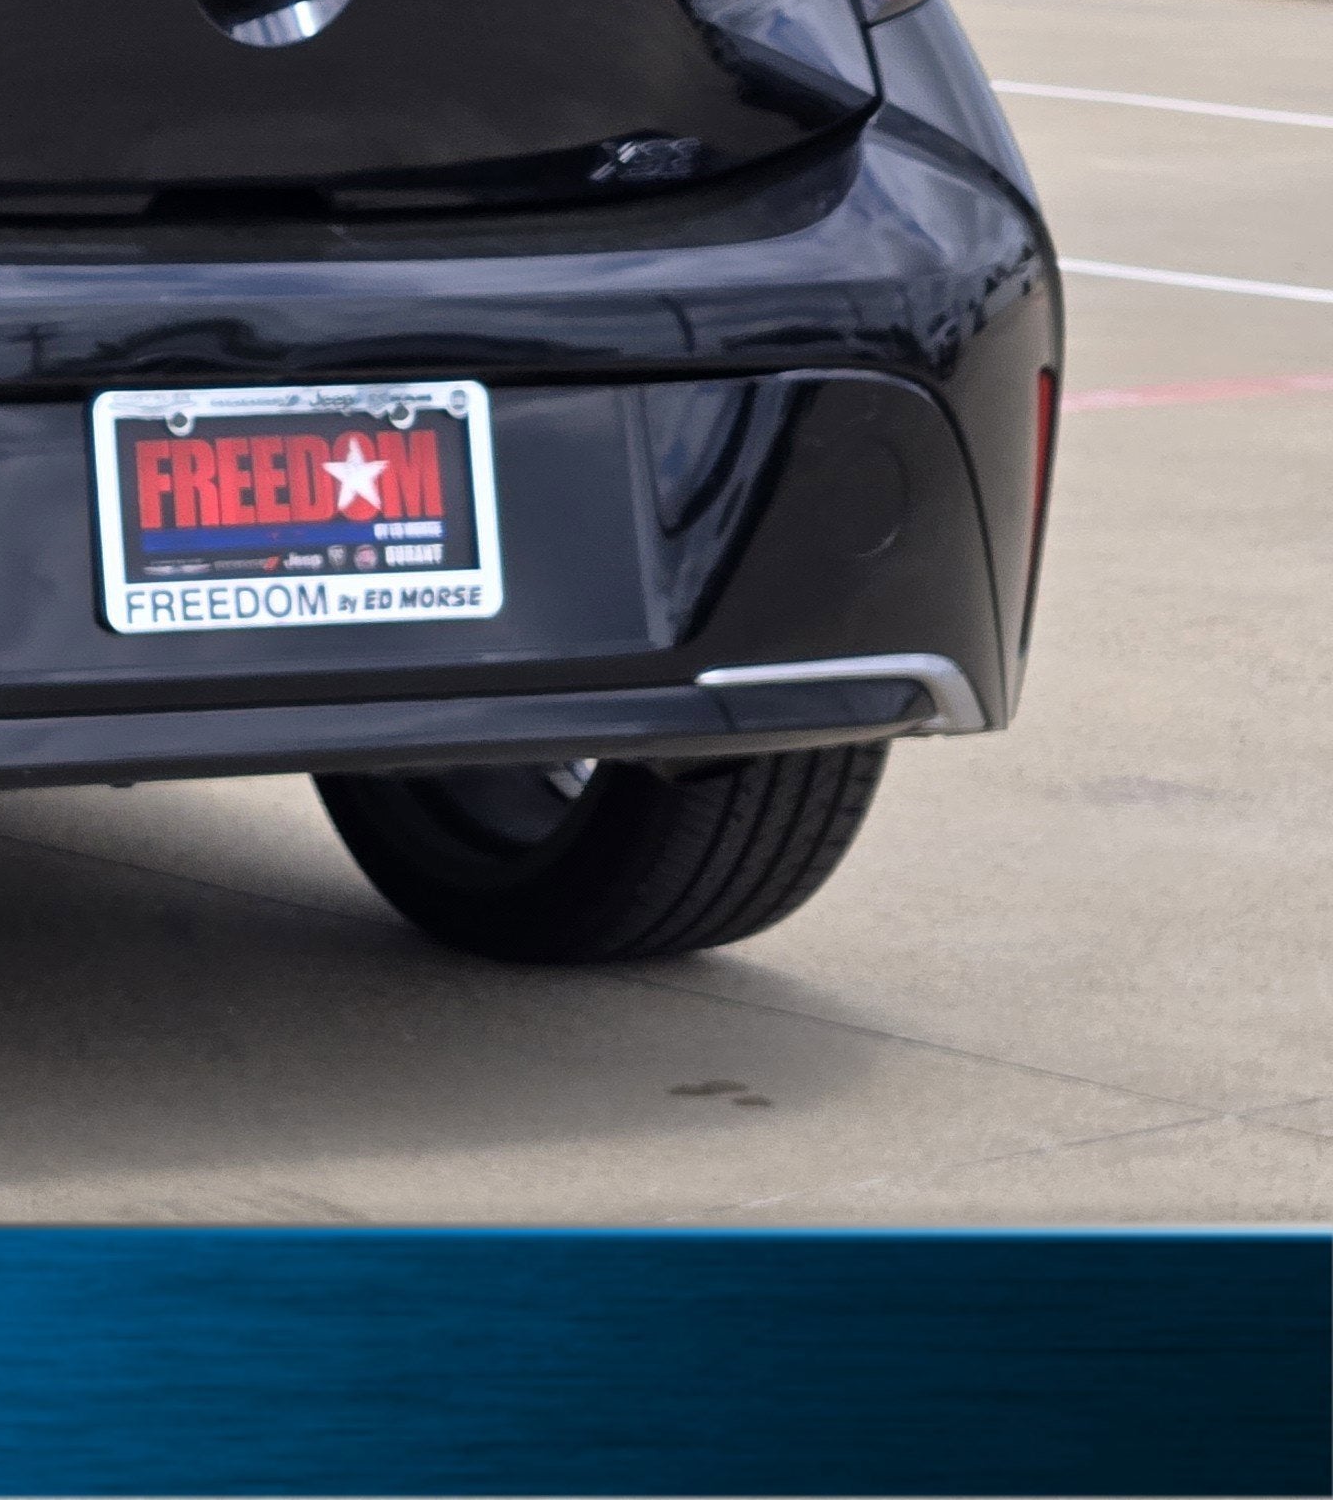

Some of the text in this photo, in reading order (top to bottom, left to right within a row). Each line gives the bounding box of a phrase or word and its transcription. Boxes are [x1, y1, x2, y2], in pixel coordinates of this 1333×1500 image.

[135, 430, 444, 530] FREEDOM
[125, 584, 329, 624] FREEDOM
[364, 589, 392, 610] ED
[400, 586, 481, 609] MORSE
